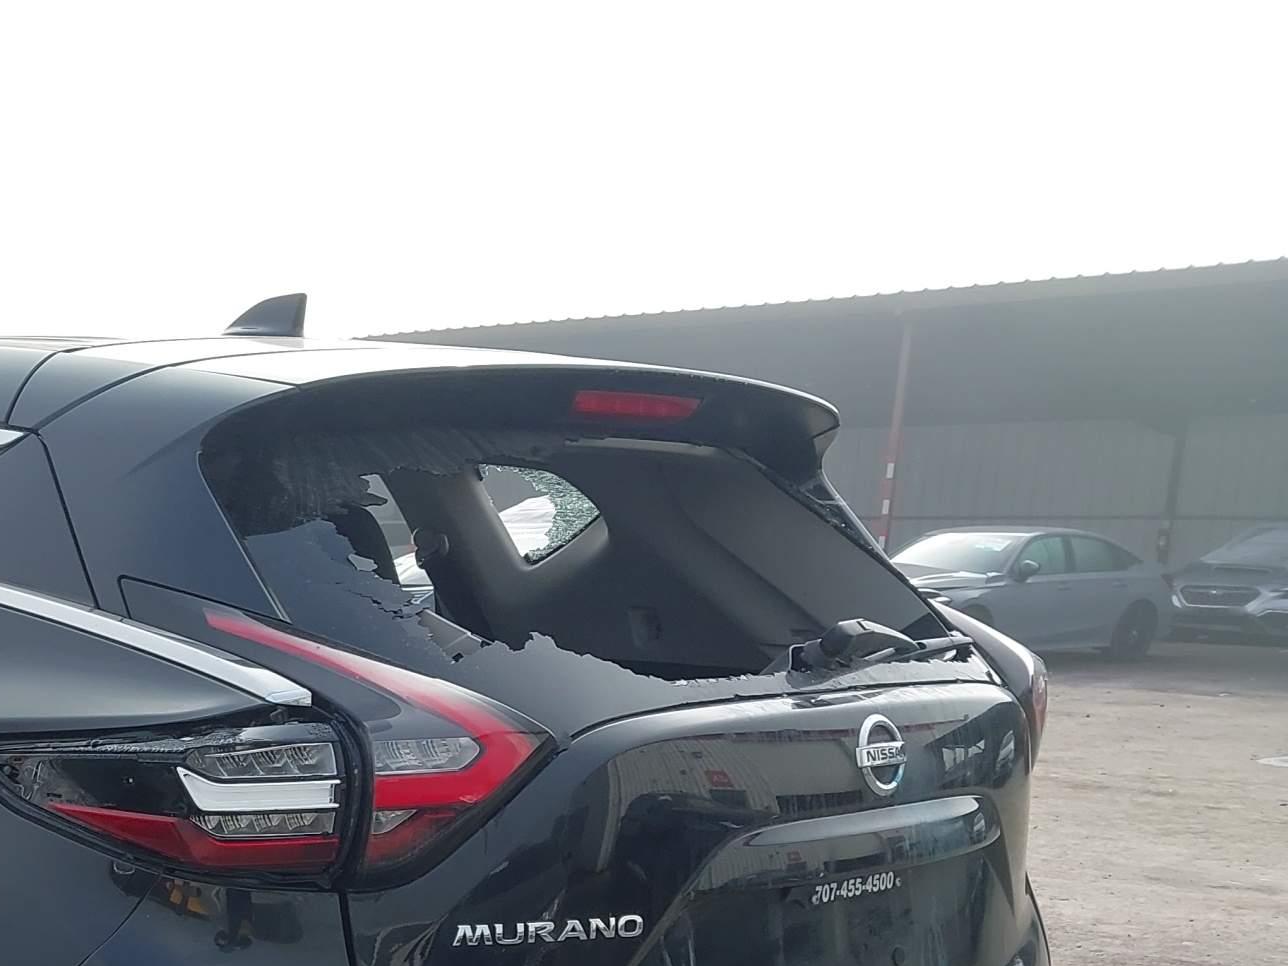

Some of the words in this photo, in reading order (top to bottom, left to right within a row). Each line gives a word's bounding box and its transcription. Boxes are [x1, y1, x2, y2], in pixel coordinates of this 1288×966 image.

[866, 747, 905, 762] NISSA
[815, 871, 894, 904] 707-455-4500
[452, 914, 644, 947] MURANO
